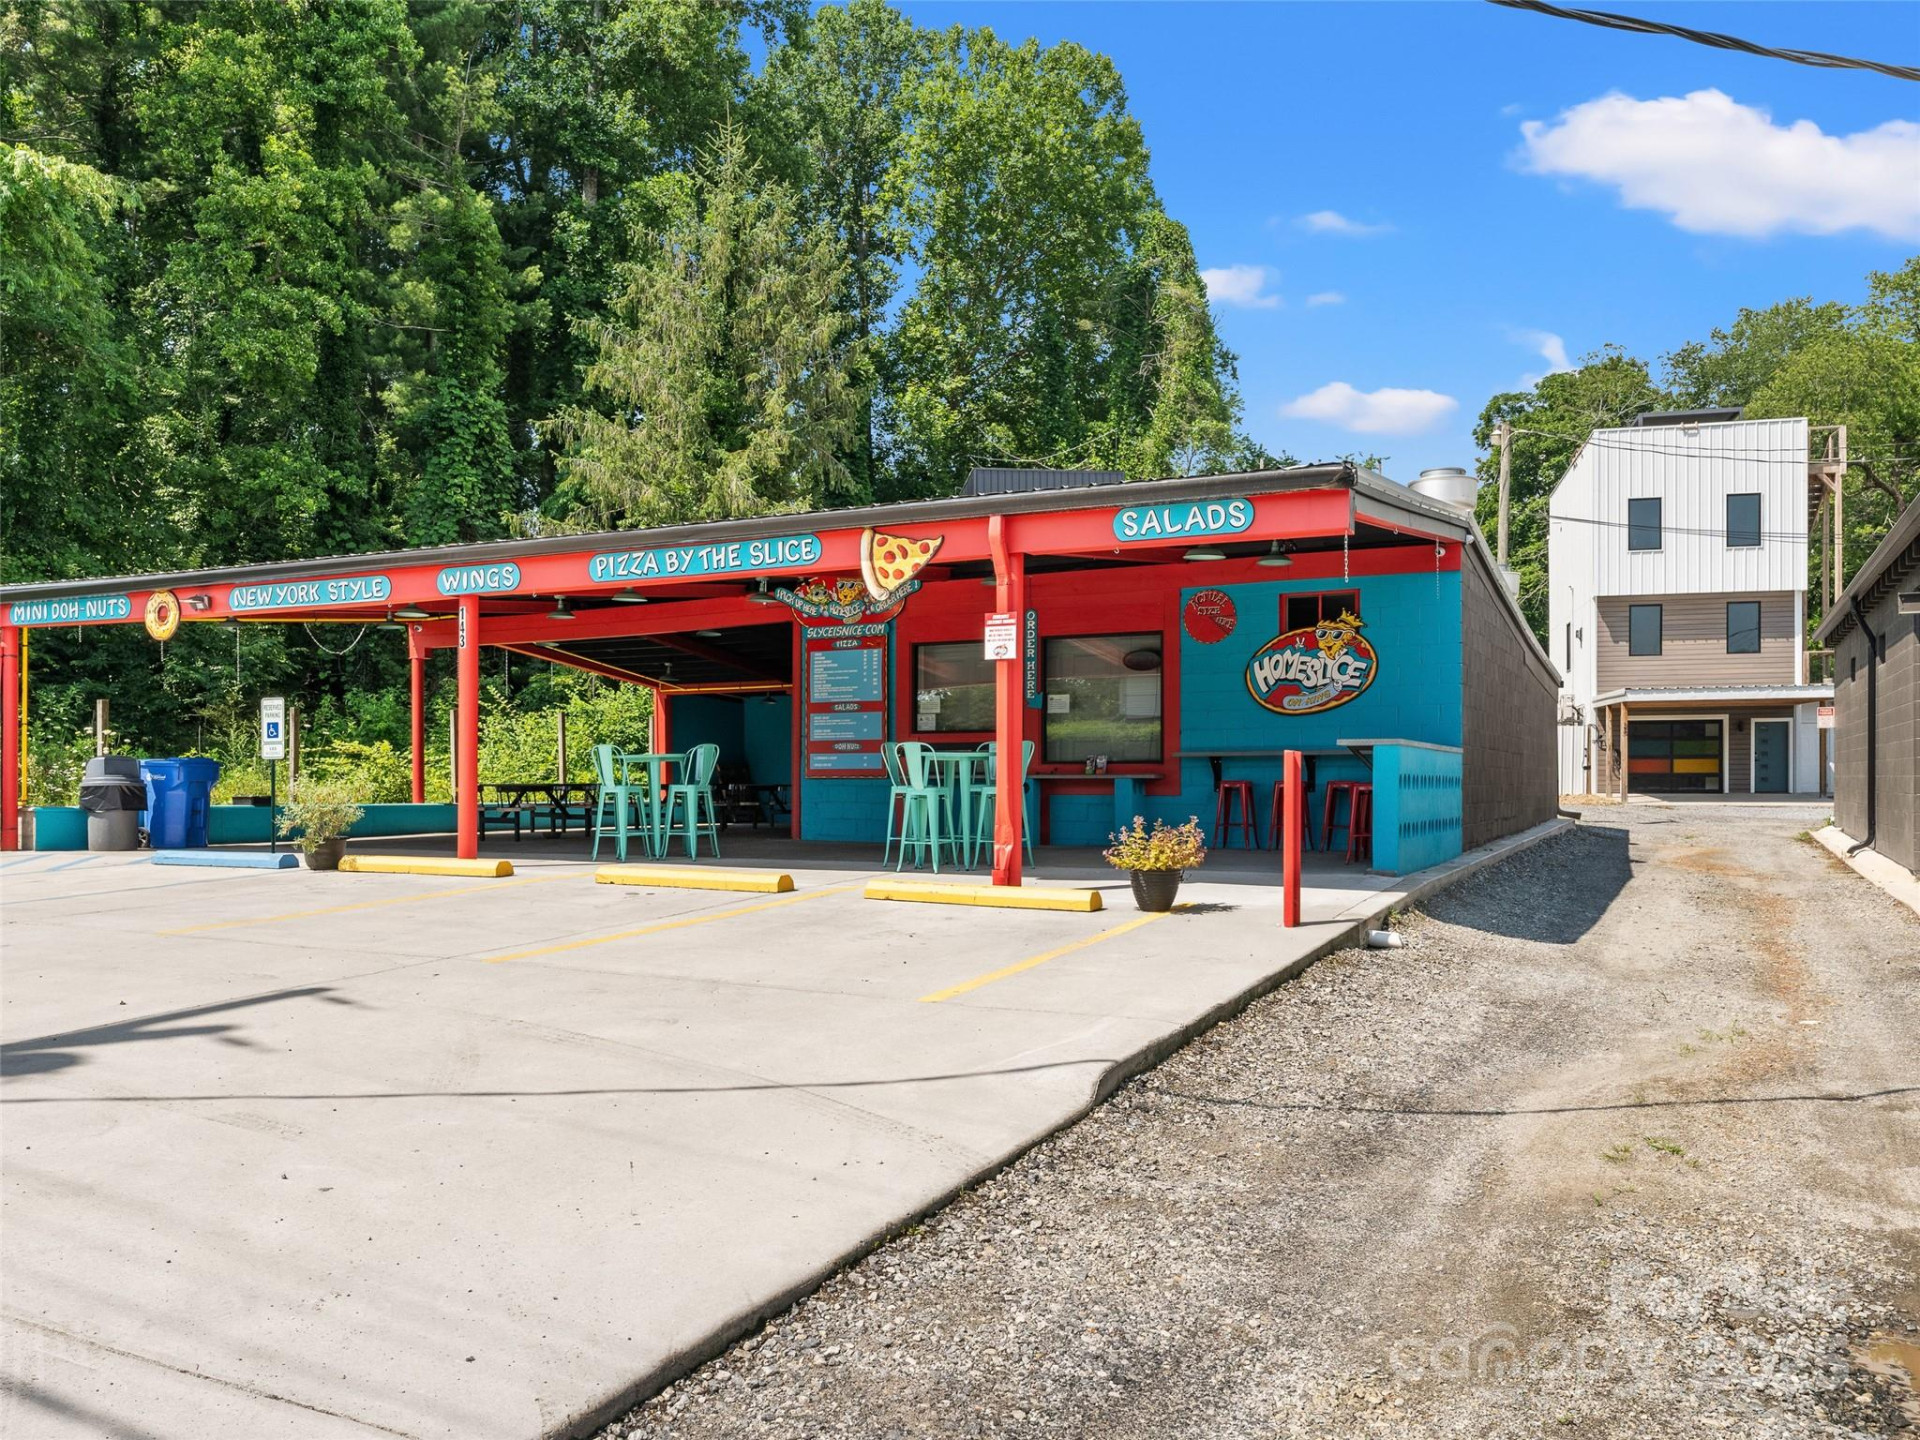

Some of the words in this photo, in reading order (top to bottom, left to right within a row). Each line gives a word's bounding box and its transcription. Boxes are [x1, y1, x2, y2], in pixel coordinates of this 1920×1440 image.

[1122, 501, 1246, 537] SALADS
[595, 552, 660, 578] PIZZA
[665, 549, 694, 573] BY
[699, 544, 743, 571] THE
[750, 538, 816, 565] SLICE
[233, 588, 272, 608] NEW
[275, 583, 320, 605] YORK
[327, 578, 384, 602] STYLE
[442, 567, 515, 591] WINGS
[13, 604, 48, 622] MINI
[51, 598, 127, 620] DOH-NUTS
[1026, 611, 1036, 658] ORDER
[1026, 661, 1036, 699] HERE
[1253, 649, 1368, 693] HOMESLYCE
